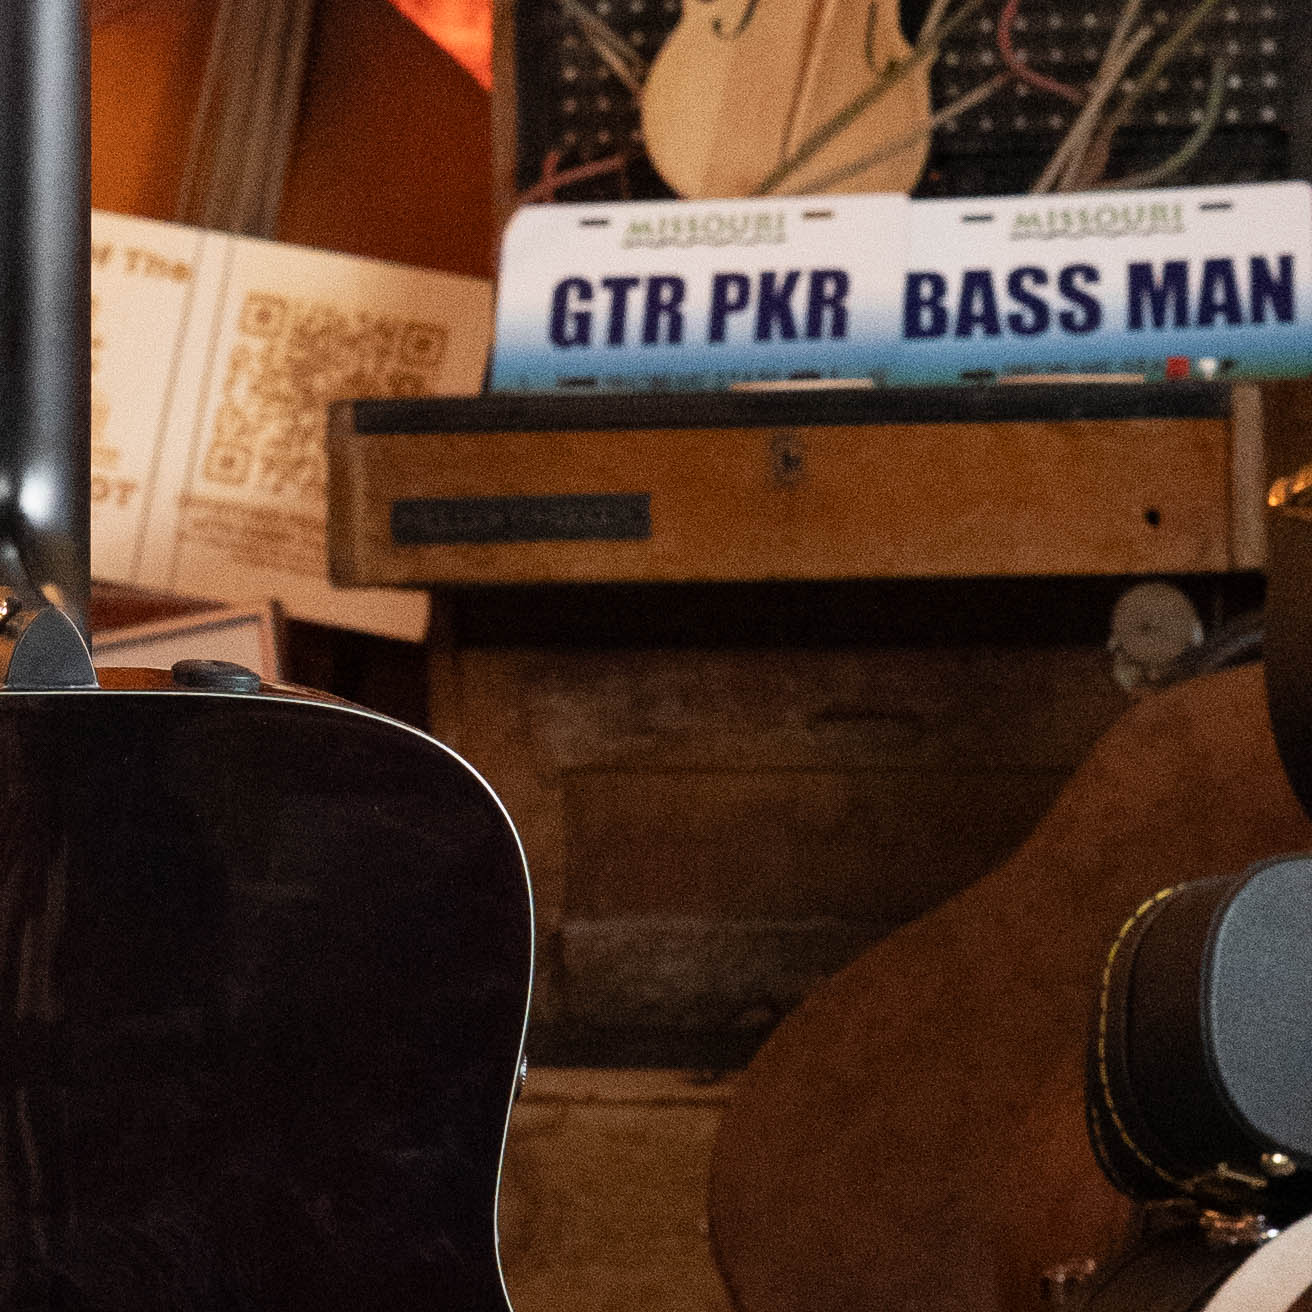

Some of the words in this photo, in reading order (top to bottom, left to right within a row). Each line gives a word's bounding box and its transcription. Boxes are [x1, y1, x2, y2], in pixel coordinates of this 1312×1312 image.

[627, 210, 787, 239] MISSOURI
[1014, 203, 1184, 233] MISSOURI
[548, 272, 687, 349] GTR
[706, 266, 851, 345] PKR
[902, 264, 1102, 340] BASS
[1127, 254, 1296, 334] MAN
